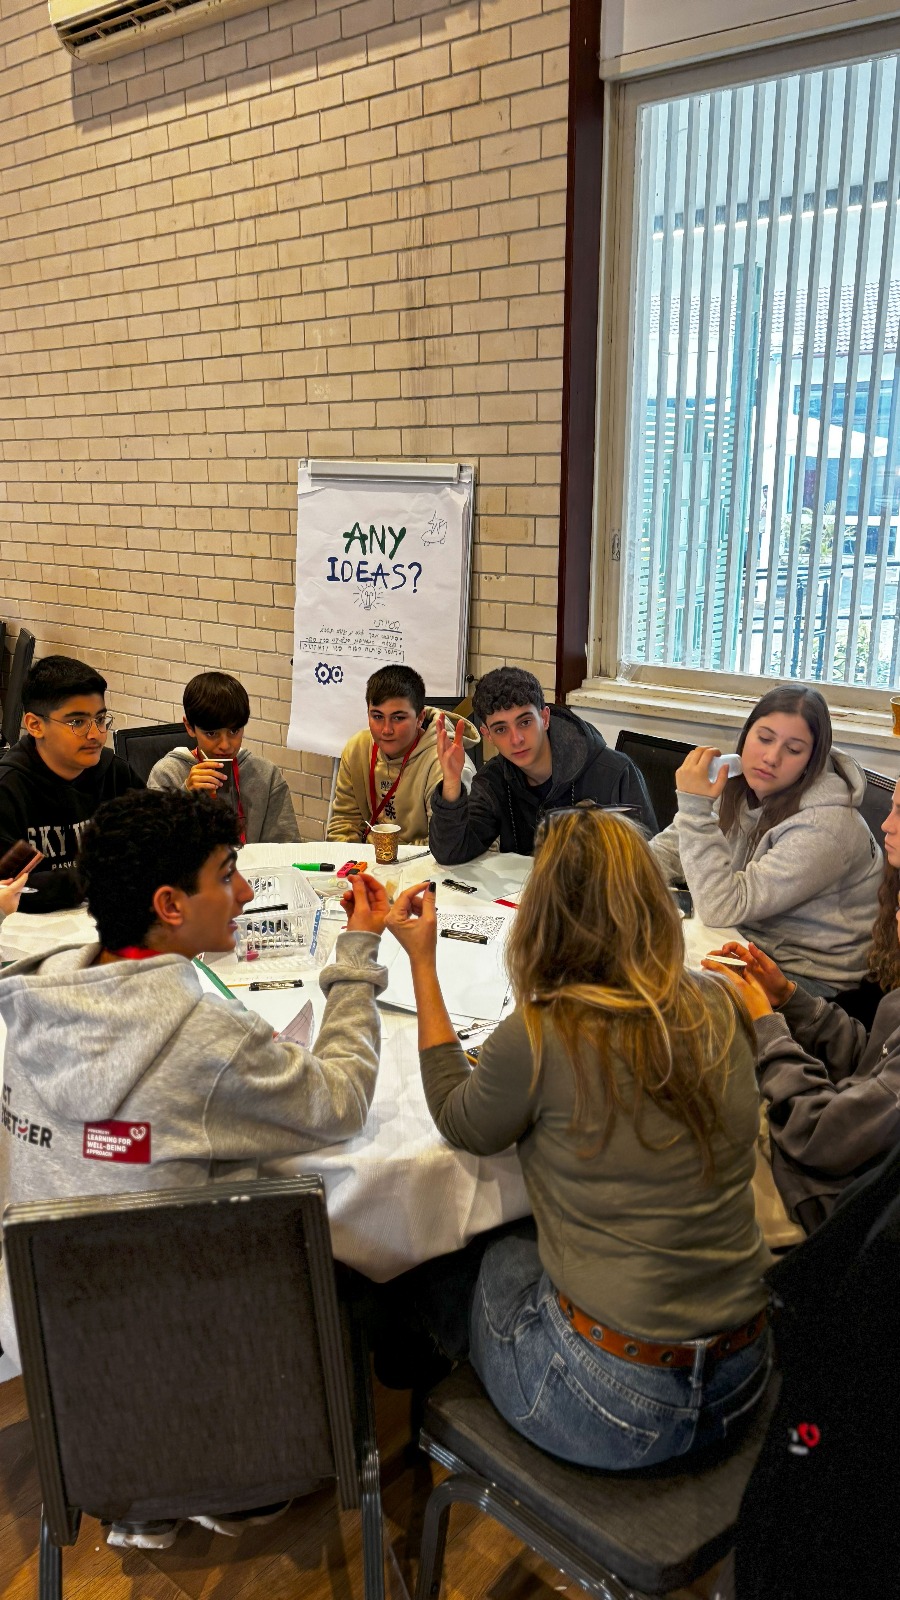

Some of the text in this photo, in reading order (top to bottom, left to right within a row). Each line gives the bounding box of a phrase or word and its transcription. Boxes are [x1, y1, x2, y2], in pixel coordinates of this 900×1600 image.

[342, 522, 407, 560] ANY
[326, 556, 422, 593] IDEAS?
[27, 825, 67, 858] SKY
[87, 1133, 132, 1146] LEARNING FOR
[87, 1141, 127, 1153] WELL-BEING
